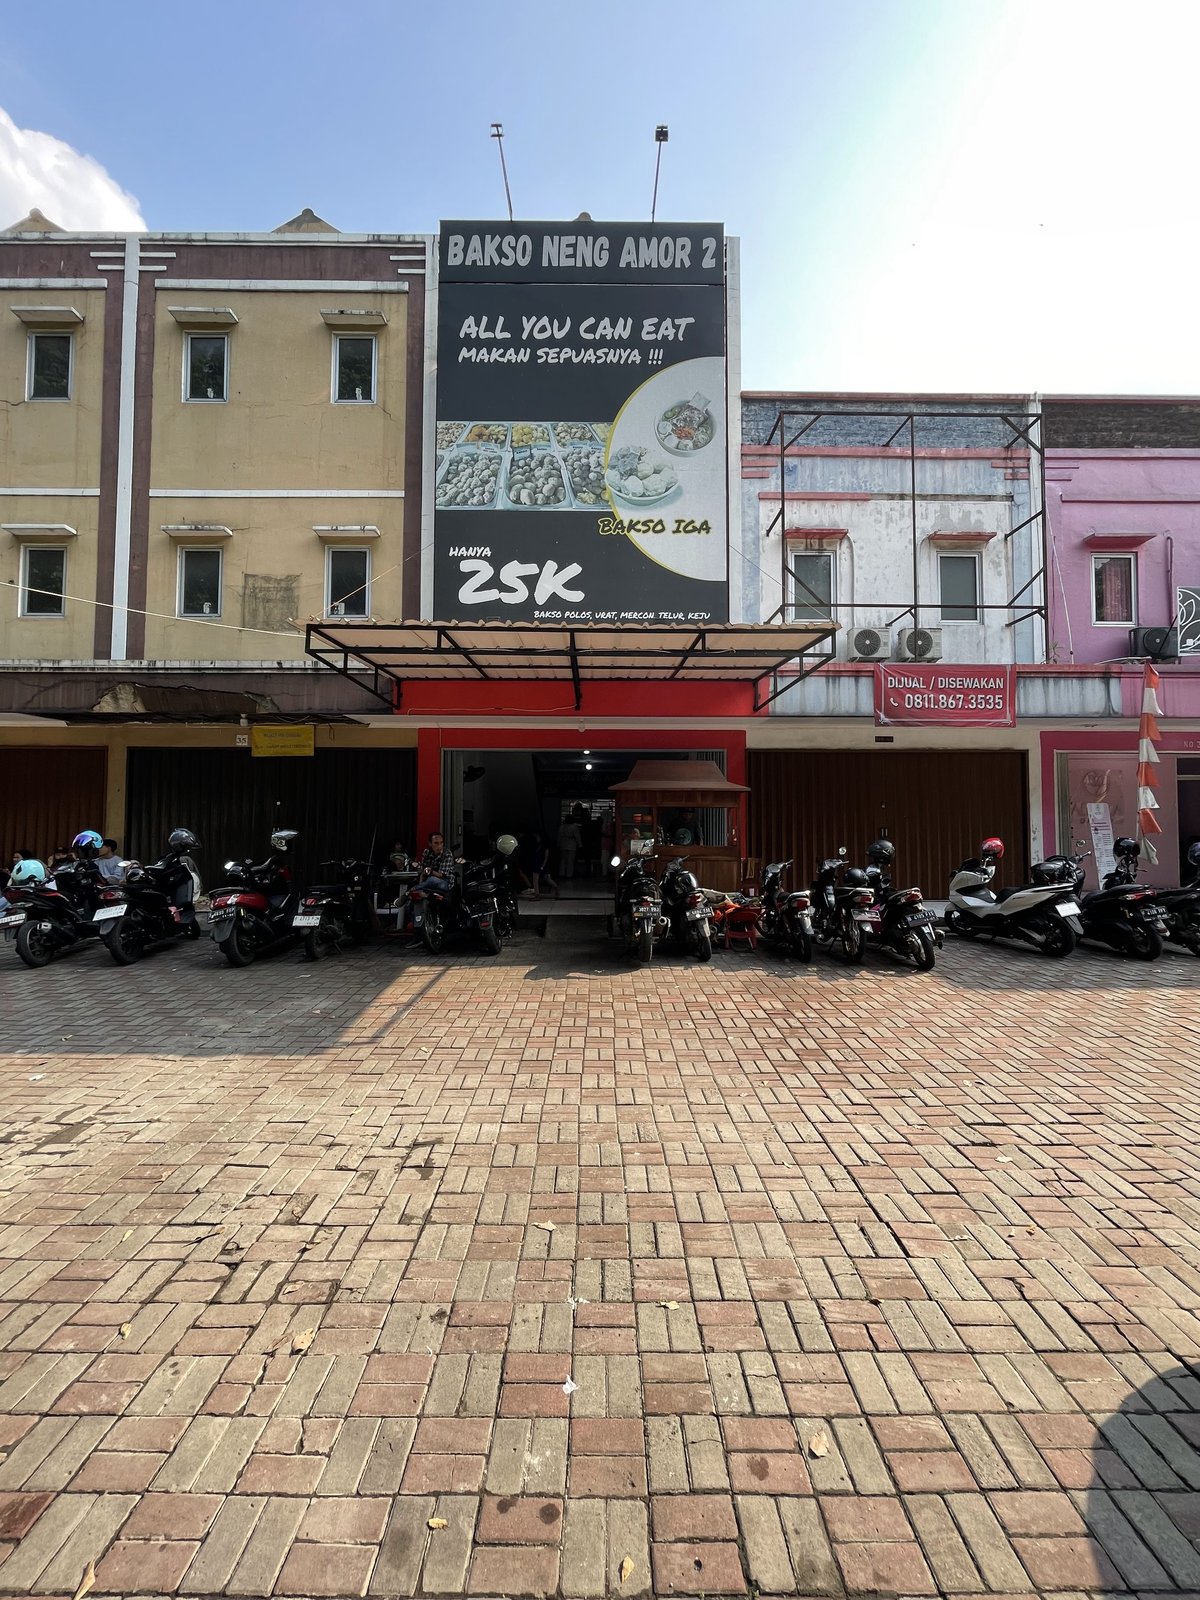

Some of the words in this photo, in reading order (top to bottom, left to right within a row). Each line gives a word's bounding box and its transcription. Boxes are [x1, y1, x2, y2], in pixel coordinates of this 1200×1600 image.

[447, 235, 532, 266] BAKSO
[542, 235, 609, 267] NENG
[619, 236, 691, 268] AMOR
[702, 237, 716, 269] 2
[459, 315, 511, 339] ALL
[522, 316, 571, 340] YOU
[579, 316, 633, 340] CAN
[641, 317, 695, 341] EAT
[458, 346, 530, 363] MAKAN
[537, 347, 642, 364] SEPUASNYA
[648, 348, 663, 365] !!!
[598, 517, 666, 535] BAKSO
[672, 518, 711, 534] IGA
[449, 546, 491, 557] HANYA
[458, 559, 585, 606] 25K
[533, 610, 562, 619] BAKSO
[564, 611, 593, 620] POLOS,
[595, 611, 617, 620] URAT,
[658, 611, 685, 621] TELUR,
[688, 612, 711, 620] KEJU
[887, 676, 926, 689] DIJUAL
[929, 675, 936, 690] /
[938, 676, 1004, 689] DISEWAKAN
[904, 693, 1003, 709] 0811.867.3535
